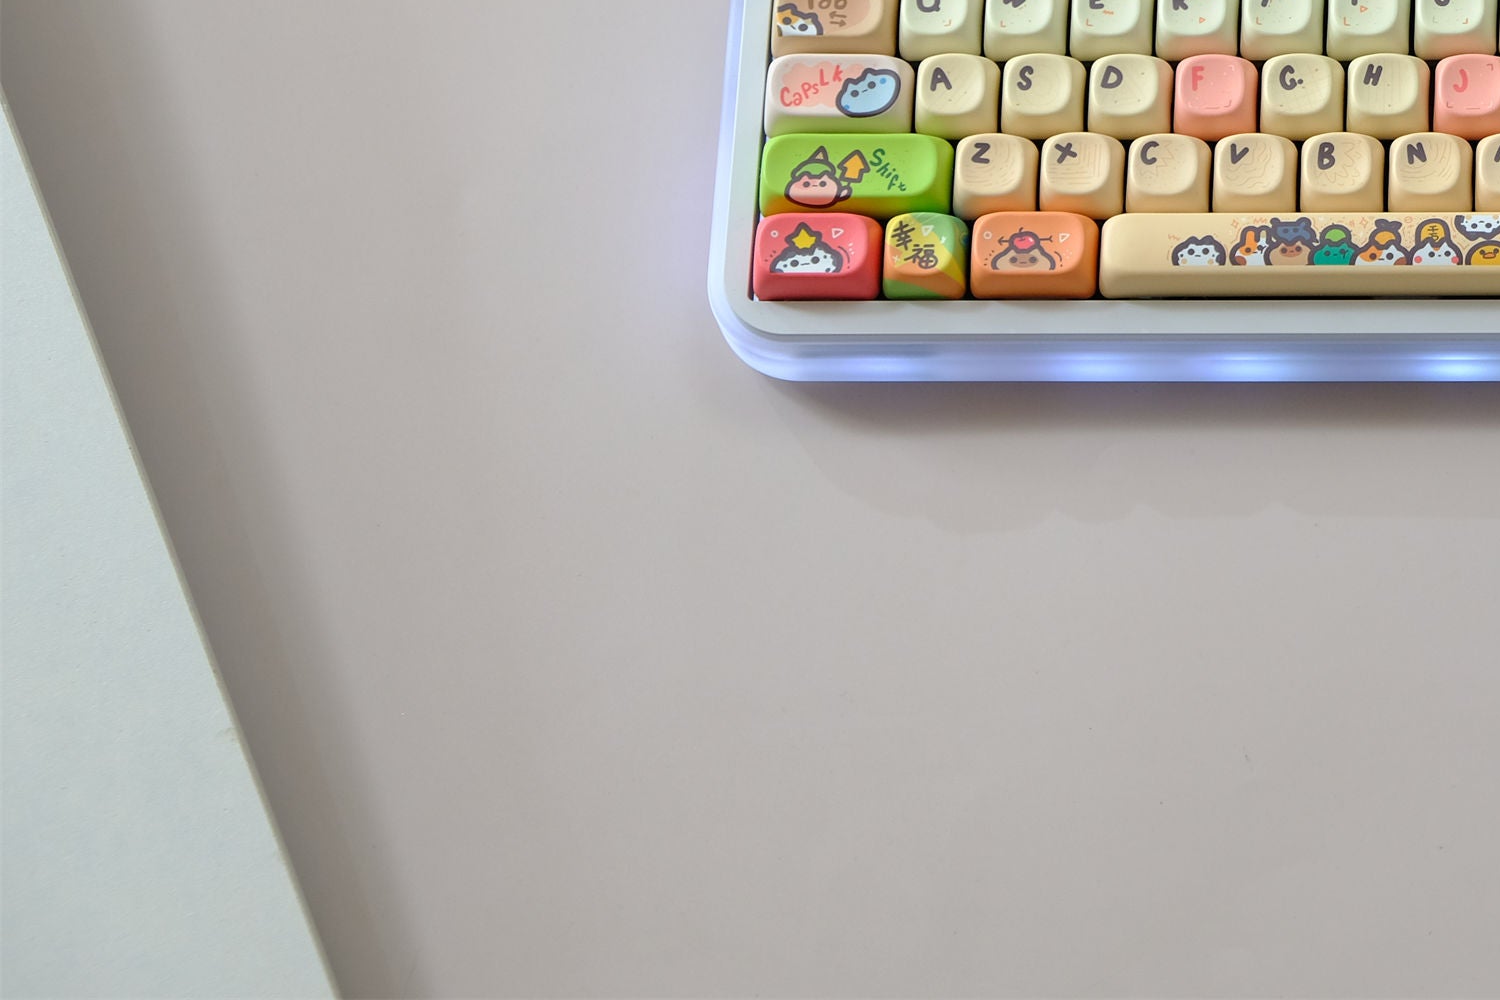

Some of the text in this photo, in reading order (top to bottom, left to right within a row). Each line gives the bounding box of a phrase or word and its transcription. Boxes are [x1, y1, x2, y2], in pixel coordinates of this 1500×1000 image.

[930, 67, 953, 91] A
[1017, 65, 1034, 90] S
[1100, 65, 1124, 89] D
[1191, 66, 1205, 91] F
[1363, 63, 1383, 87] H
[1453, 68, 1469, 93] J
[971, 142, 991, 164] Z
[1054, 142, 1078, 164] X
[1140, 141, 1159, 165] C
[1230, 143, 1249, 164] V
[1317, 142, 1336, 170] B
[1406, 143, 1427, 164] N
[868, 147, 908, 192] Shift
